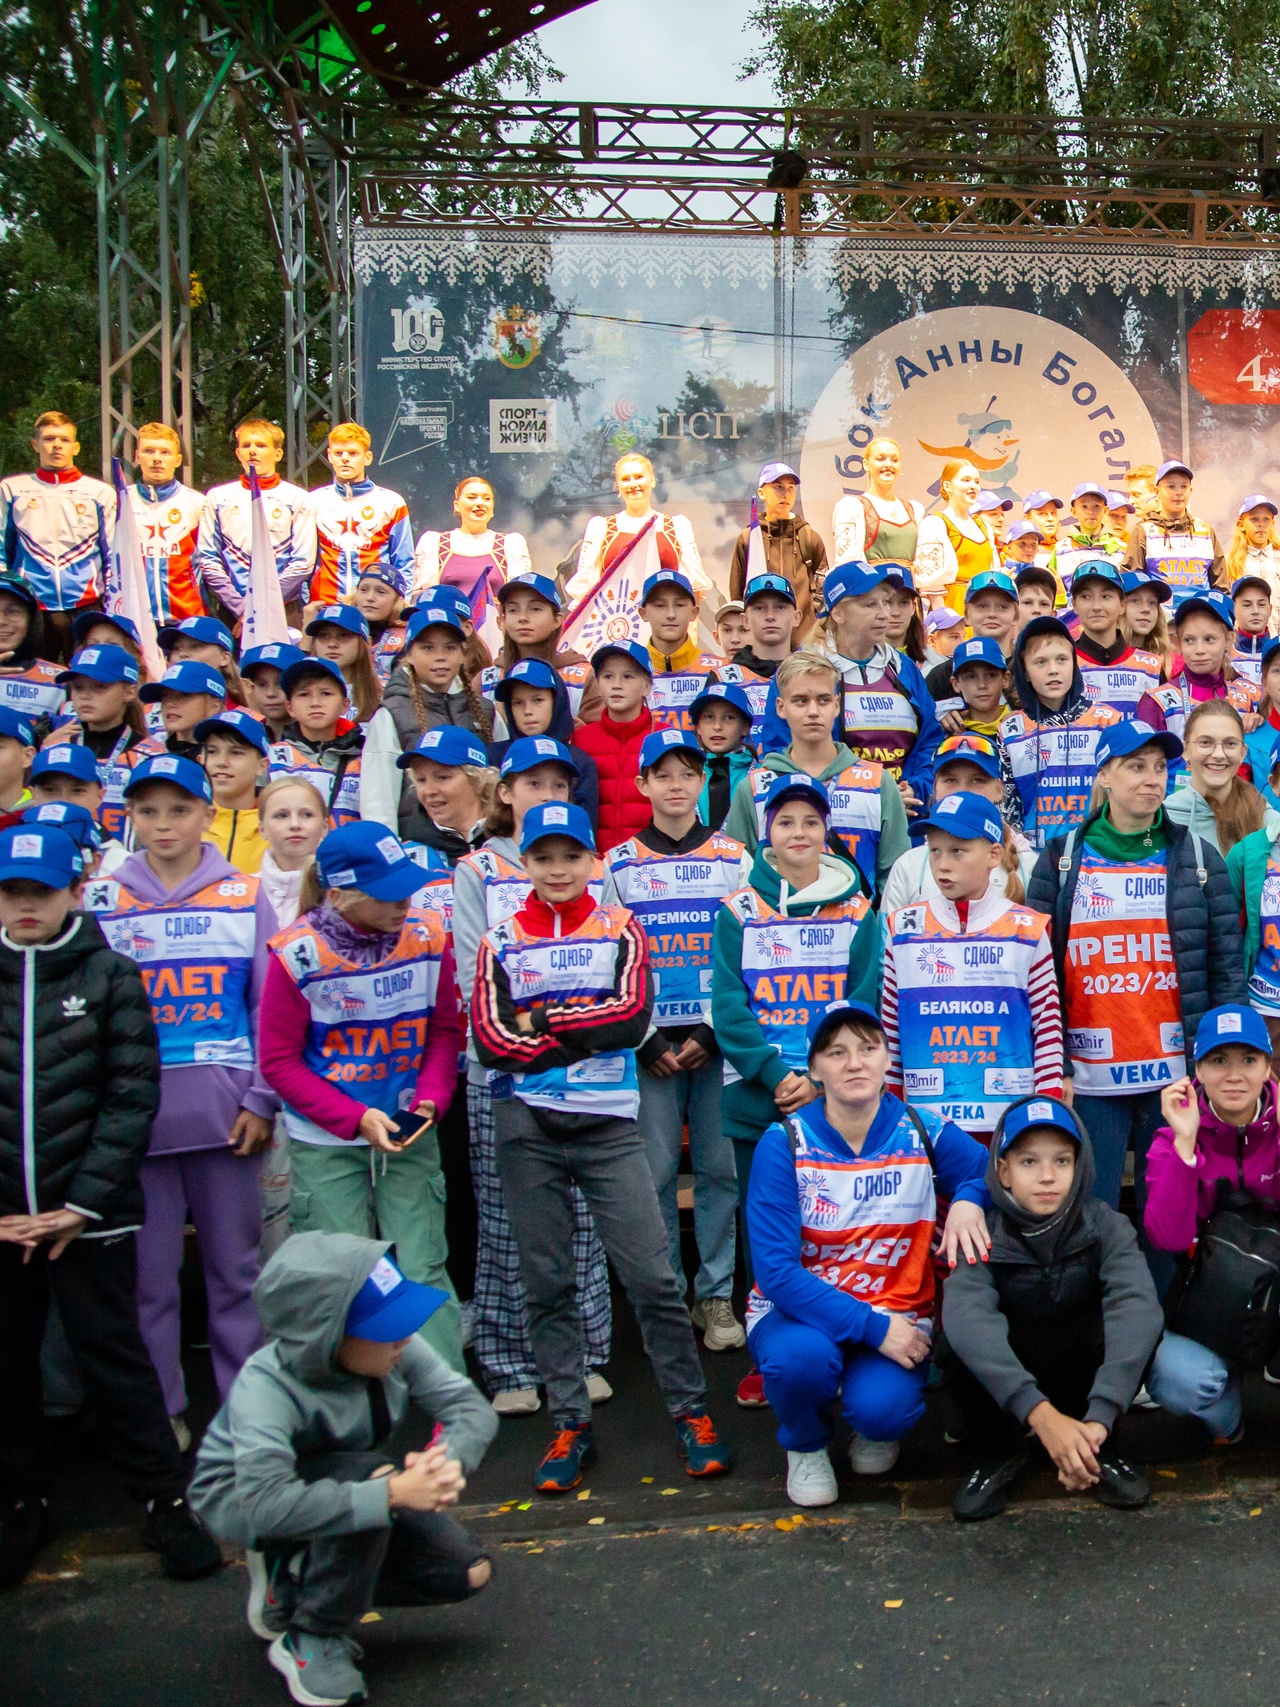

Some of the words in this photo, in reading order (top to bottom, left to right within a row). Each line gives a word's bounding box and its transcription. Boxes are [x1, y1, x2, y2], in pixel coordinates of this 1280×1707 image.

[894, 339, 1023, 391] Анны
[499, 408, 537, 419] СПОРТ
[499, 420, 547, 431] НОРМА
[499, 433, 547, 443] ЖИЗНИ
[140, 541, 180, 557] СКА
[1158, 560, 1206, 573] АТЛЕТ
[1134, 654, 1158, 667] 140
[670, 679, 700, 693] СДЮБР
[1107, 673, 1137, 689] СДЮБР
[6, 683, 39, 699] СДЮБР
[860, 696, 894, 712] СДЮБР
[1094, 708, 1114, 719] 59
[1057, 734, 1090, 750] СДЮБР
[851, 768, 874, 780] 70
[1035, 795, 1088, 812] АТЛЕТ
[711, 839, 739, 851] 156
[675, 865, 711, 882] СДЮБР
[217, 883, 248, 897] 88
[1124, 877, 1165, 899] СДЮБ
[165, 916, 211, 939] СДЮБР
[1013, 914, 1033, 927] 13
[648, 932, 713, 953] АТЛЕТ
[800, 928, 835, 948] СДЮБР
[963, 946, 1004, 967] СДЮБР
[1067, 933, 1173, 967] ТРЕНЕ
[551, 948, 593, 970] СДЮБР
[650, 954, 710, 970] 2023/24
[140, 965, 229, 998] ТЛЕТ
[373, 969, 414, 999] СДЮБР
[753, 973, 848, 1003] АТЛЕТ
[1082, 971, 1178, 996] 2023/24
[152, 1001, 223, 1027] 23/24
[657, 1002, 702, 1017] VEKA
[919, 1001, 994, 1015] БЕЛЯКОВ
[998, 1001, 1010, 1015] А
[323, 1017, 428, 1058] АТЛЕТ
[929, 1025, 1001, 1047] АТЛЕТ
[932, 1050, 997, 1064] 2023/24
[905, 1073, 938, 1088] skimir
[1110, 1061, 1172, 1085] VEKA
[941, 1105, 985, 1120] VEKA
[801, 1238, 912, 1267] РЕНЕР
